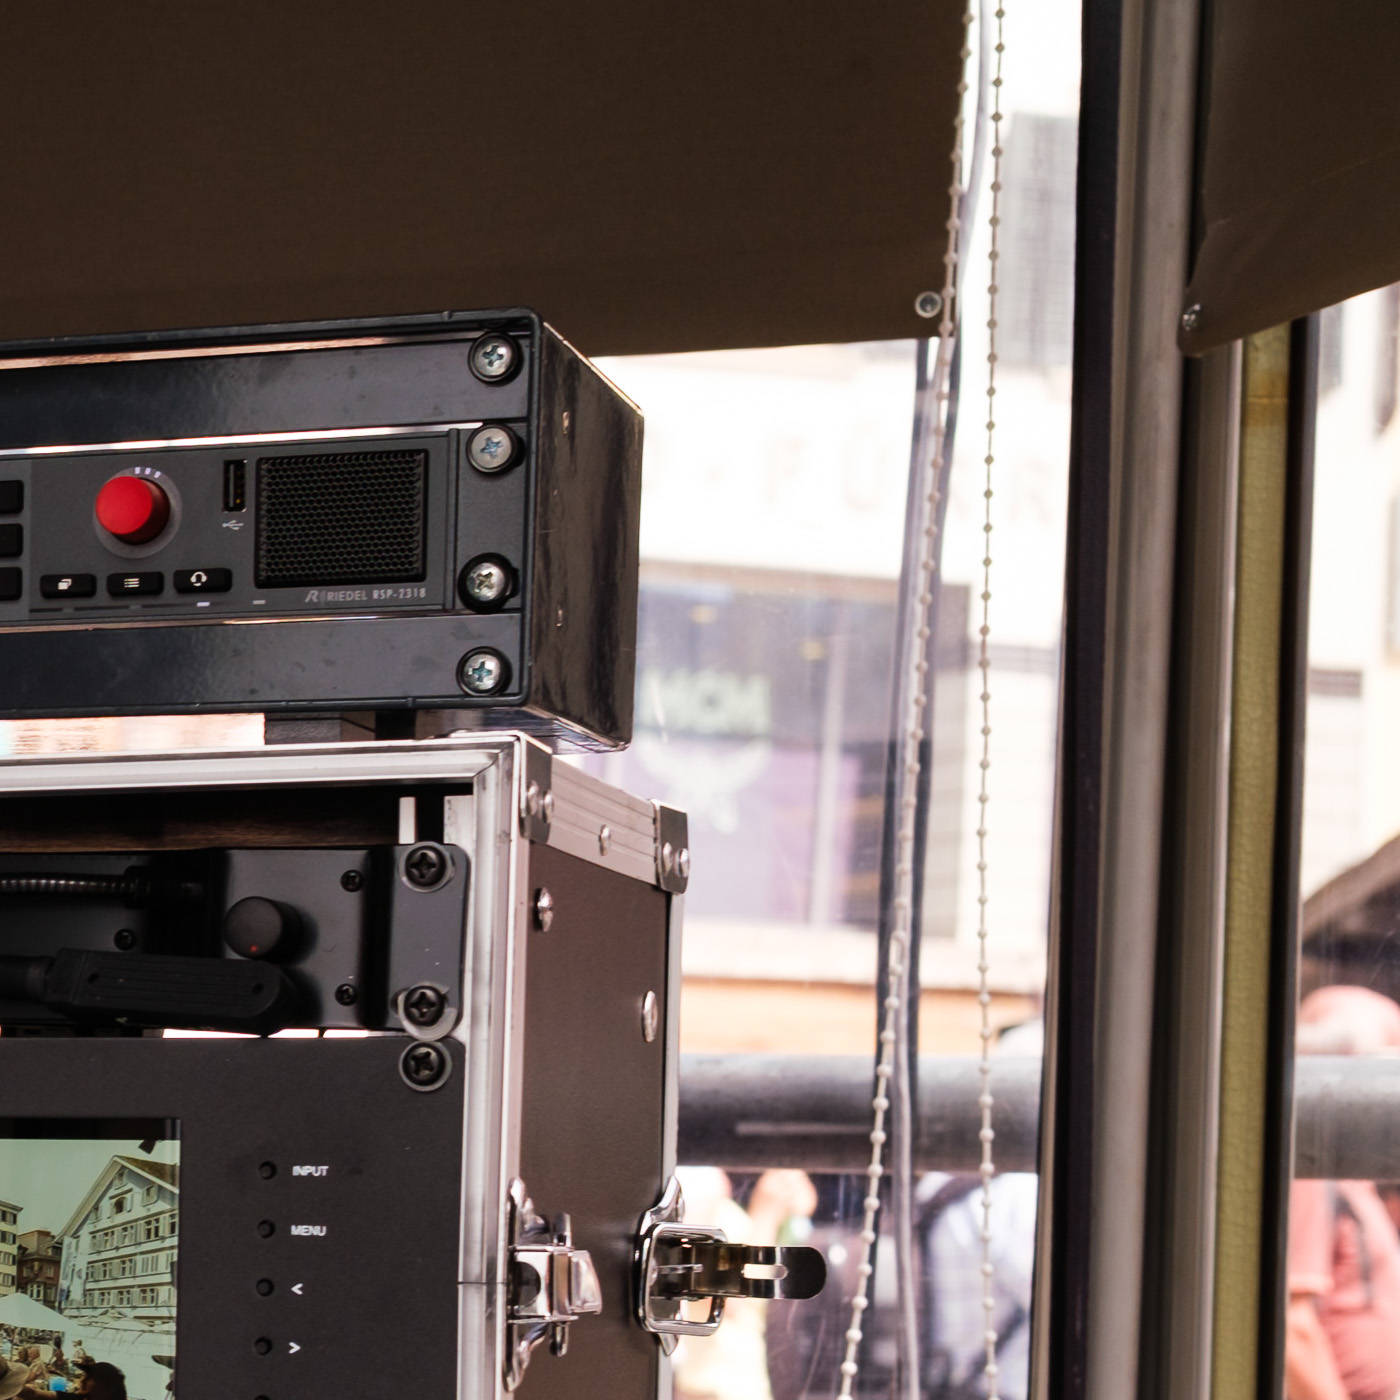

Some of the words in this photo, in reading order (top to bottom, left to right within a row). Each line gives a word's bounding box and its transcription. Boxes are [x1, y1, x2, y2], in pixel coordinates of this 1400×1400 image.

[327, 589, 368, 601] RIEDEL
[372, 587, 427, 600] RSP-2318
[292, 1165, 329, 1177] INPUT
[290, 1224, 327, 1237] MENU
